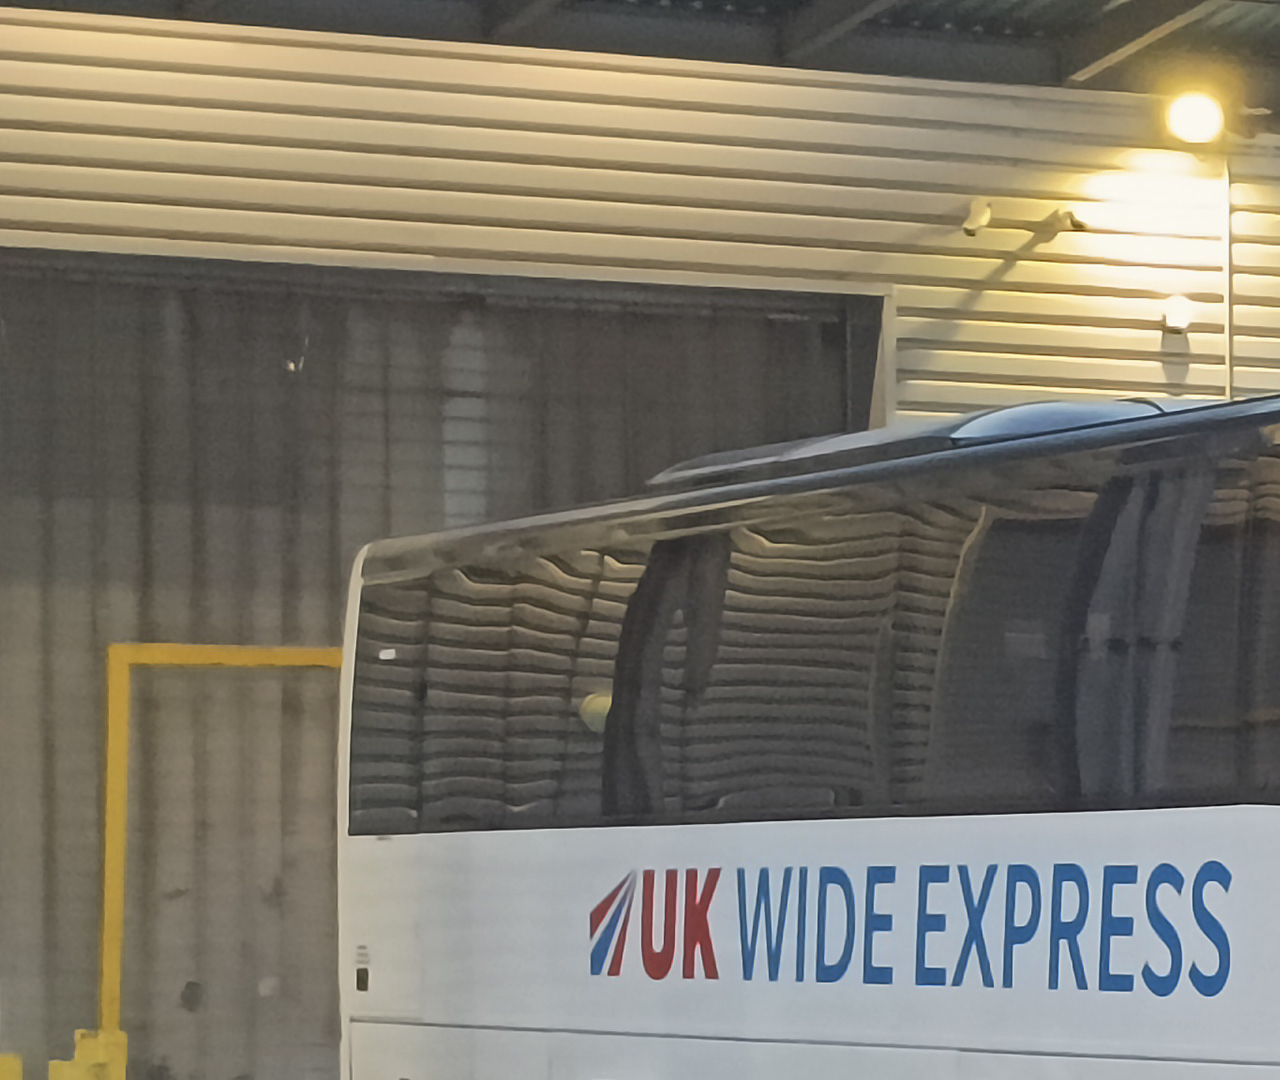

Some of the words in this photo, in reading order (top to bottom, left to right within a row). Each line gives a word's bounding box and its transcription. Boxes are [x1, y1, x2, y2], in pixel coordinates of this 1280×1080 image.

[641, 867, 722, 981] UK
[736, 866, 897, 985] WIDE
[914, 860, 1233, 997] EXPRESS
